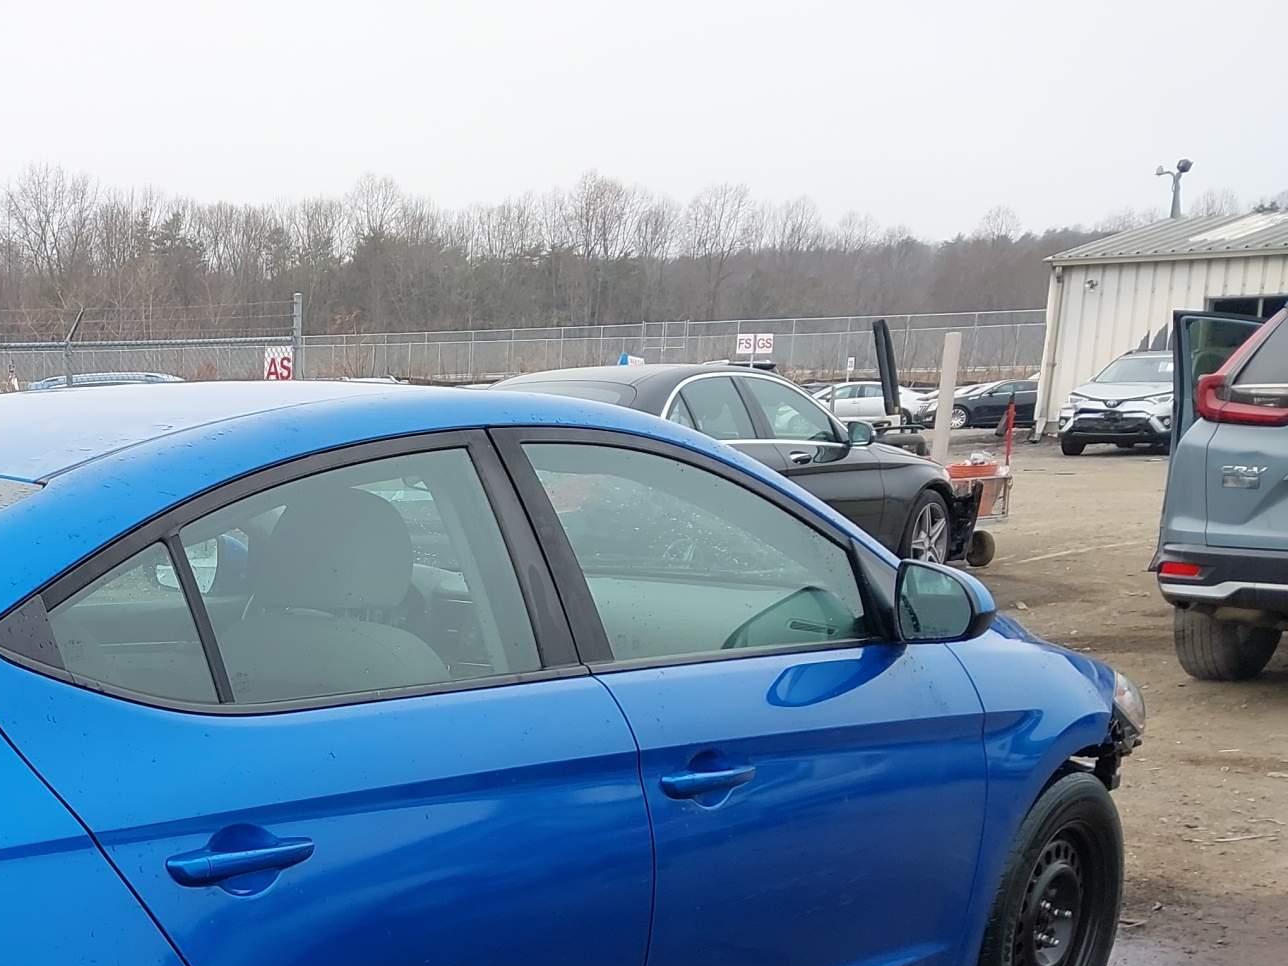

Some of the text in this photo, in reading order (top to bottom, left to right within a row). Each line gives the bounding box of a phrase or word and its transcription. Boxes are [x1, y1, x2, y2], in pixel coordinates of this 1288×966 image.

[738, 338, 752, 349] FS
[757, 337, 773, 349] GS
[266, 356, 292, 380] AS
